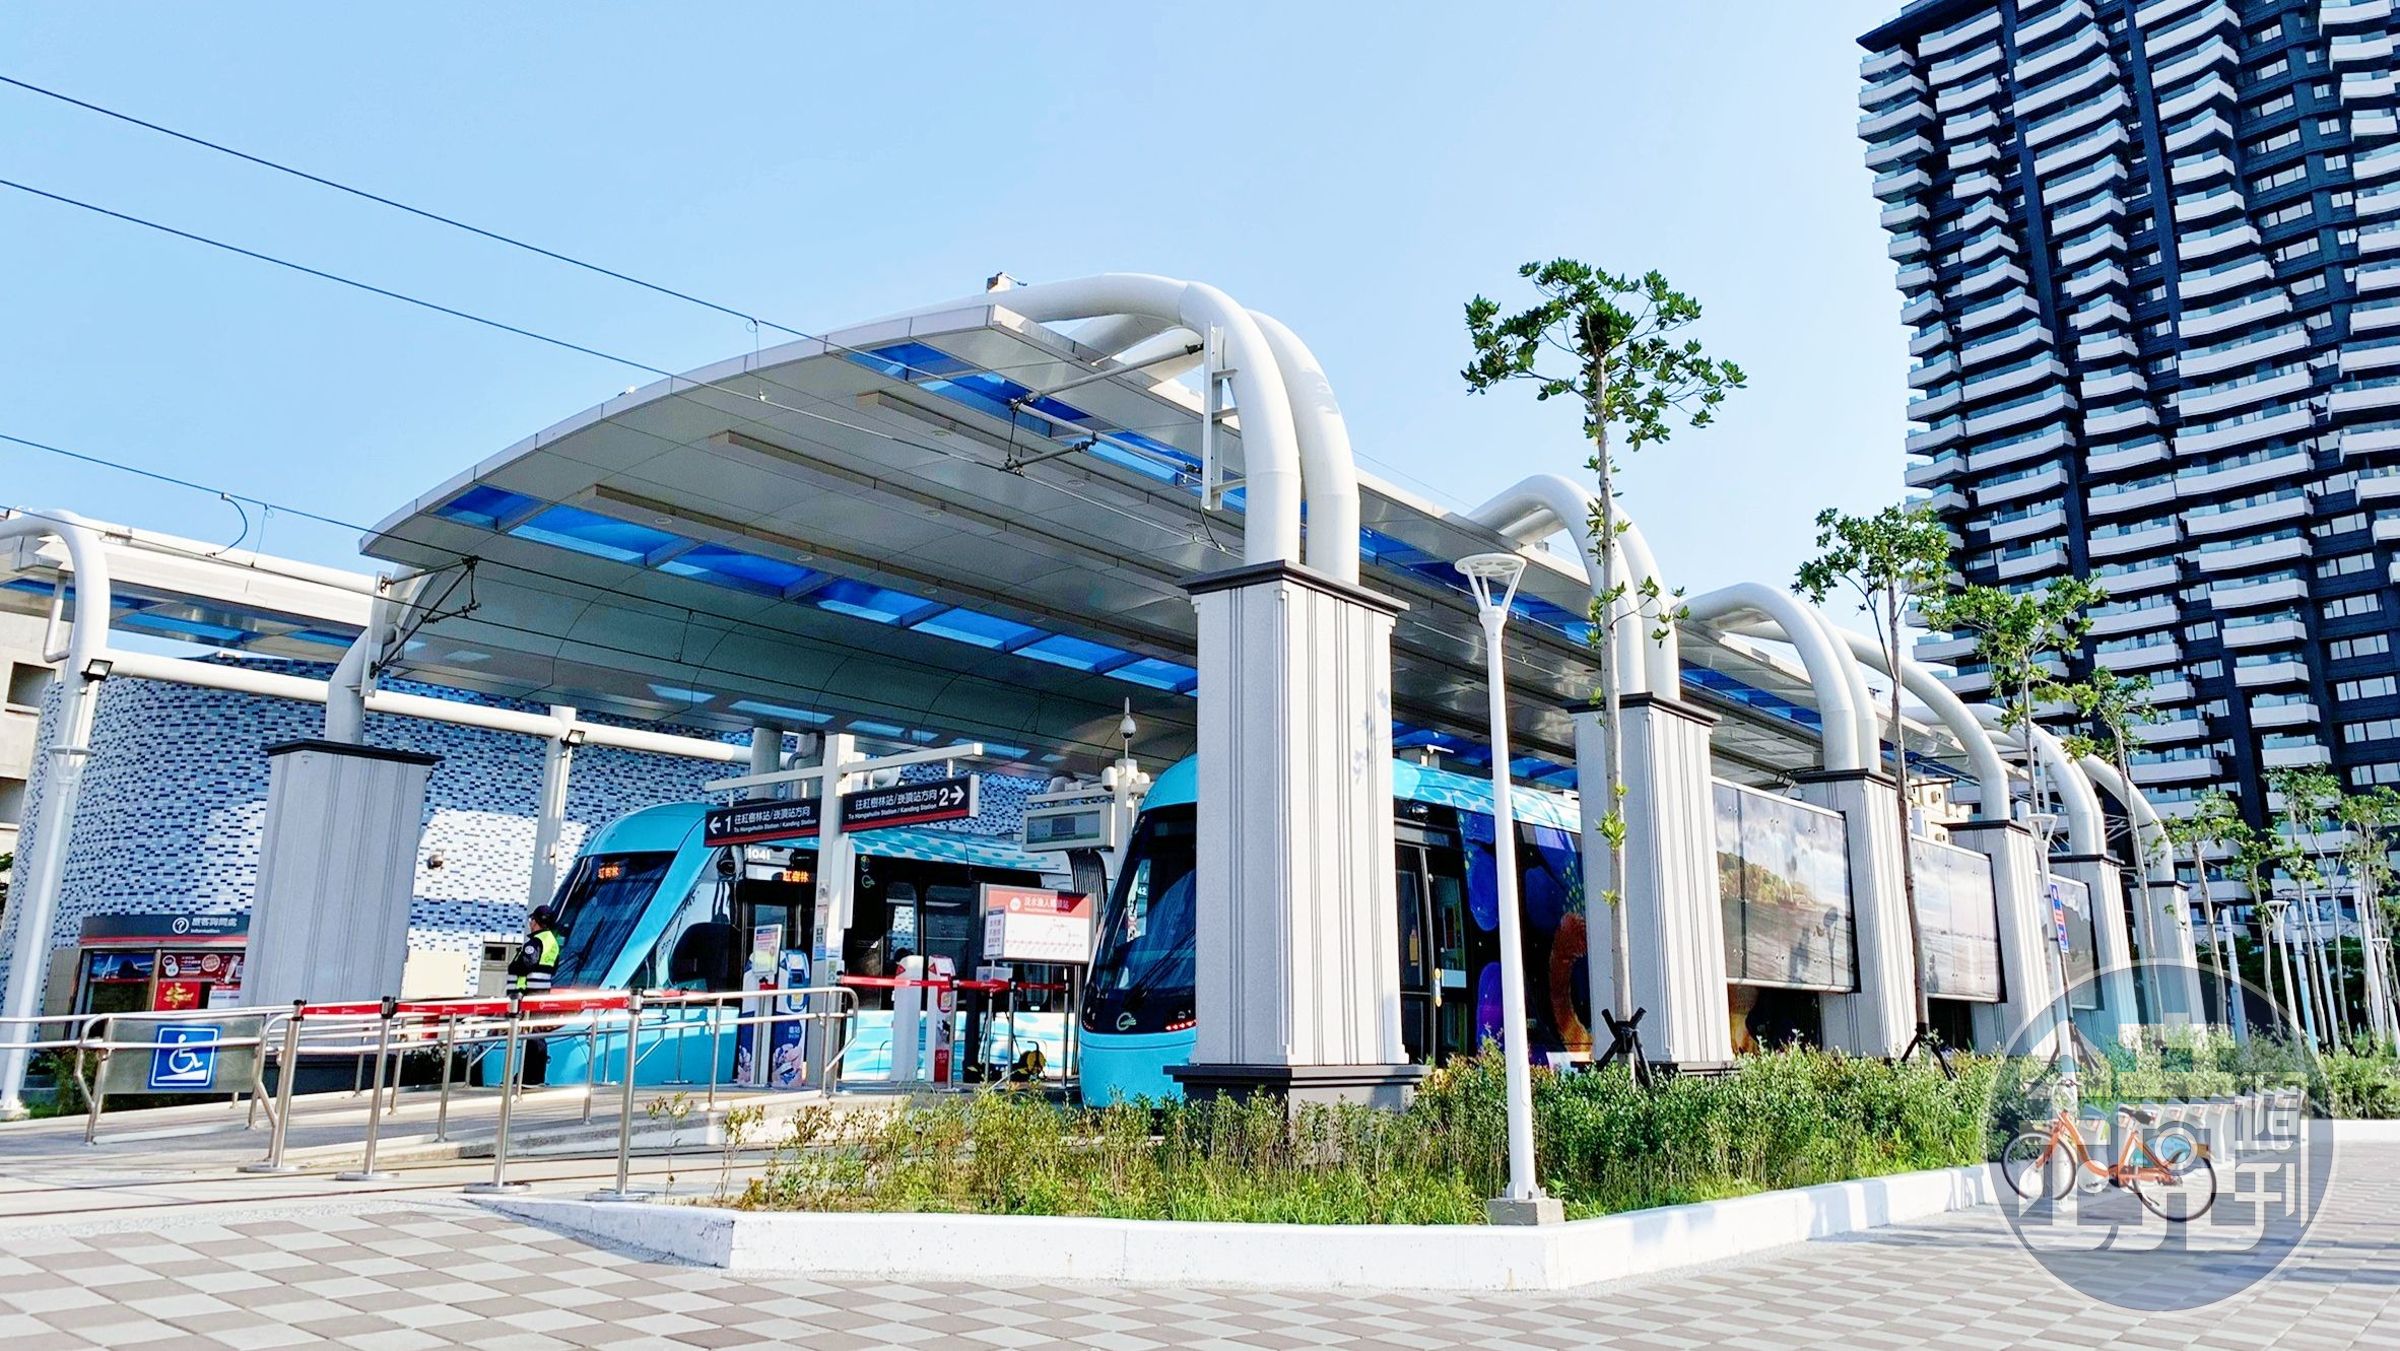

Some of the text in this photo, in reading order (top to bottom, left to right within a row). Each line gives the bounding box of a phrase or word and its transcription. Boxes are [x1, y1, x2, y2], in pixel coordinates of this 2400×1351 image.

[939, 788, 949, 807] 2
[881, 808, 897, 816] Station
[920, 803, 937, 811] Station
[725, 816, 732, 833] 1
[782, 820, 800, 828] Kanding
[748, 847, 771, 860] 1041
